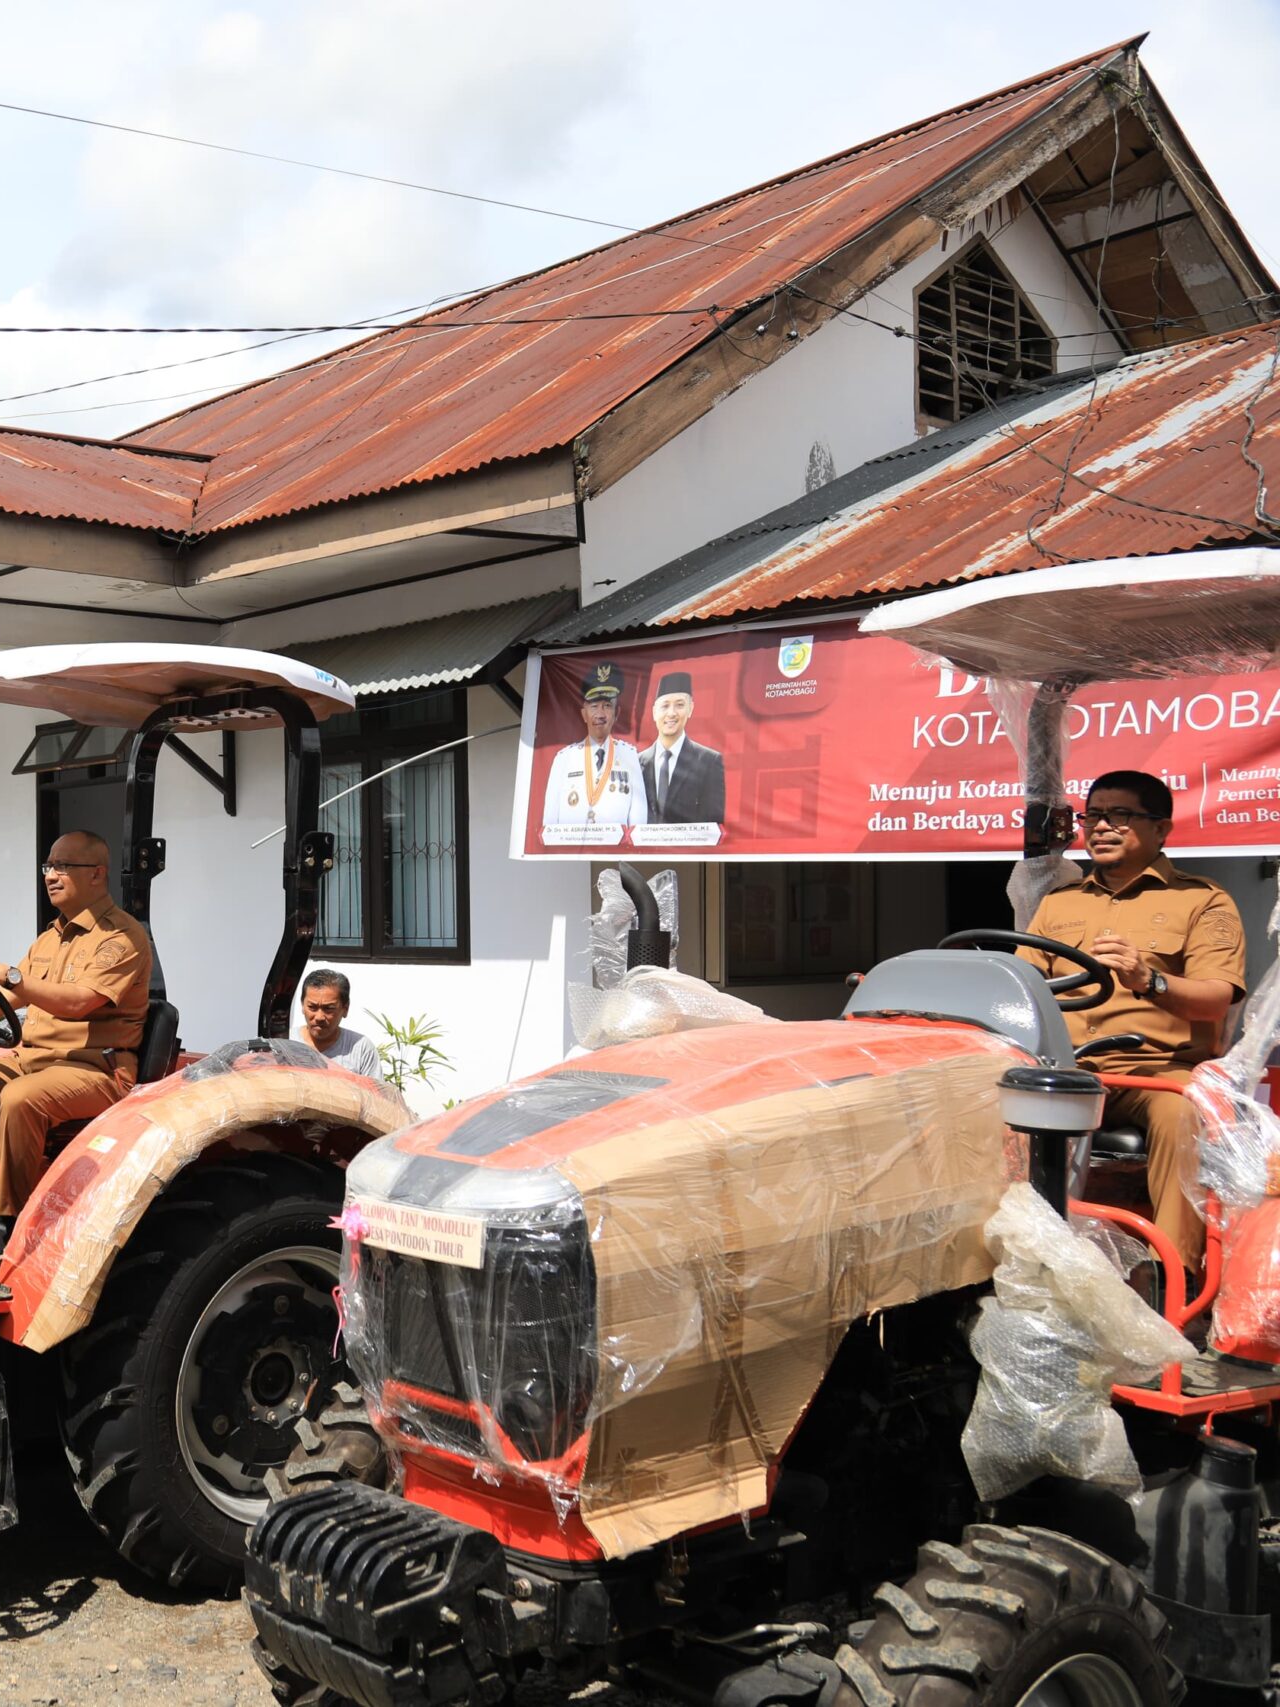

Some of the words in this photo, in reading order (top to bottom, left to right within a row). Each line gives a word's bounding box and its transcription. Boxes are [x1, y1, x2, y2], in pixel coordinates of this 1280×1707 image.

[765, 681, 801, 690] PEMERINTAH
[765, 687, 816, 698] KOTAMOBAGU
[868, 780, 952, 805] Menuju
[867, 811, 907, 832] dan
[912, 809, 1005, 835] Berdaya
[1216, 809, 1252, 824] dan
[400, 1211, 418, 1228] TANI
[386, 1229, 430, 1253] PONTODON
[434, 1241, 464, 1258] TIMUR
